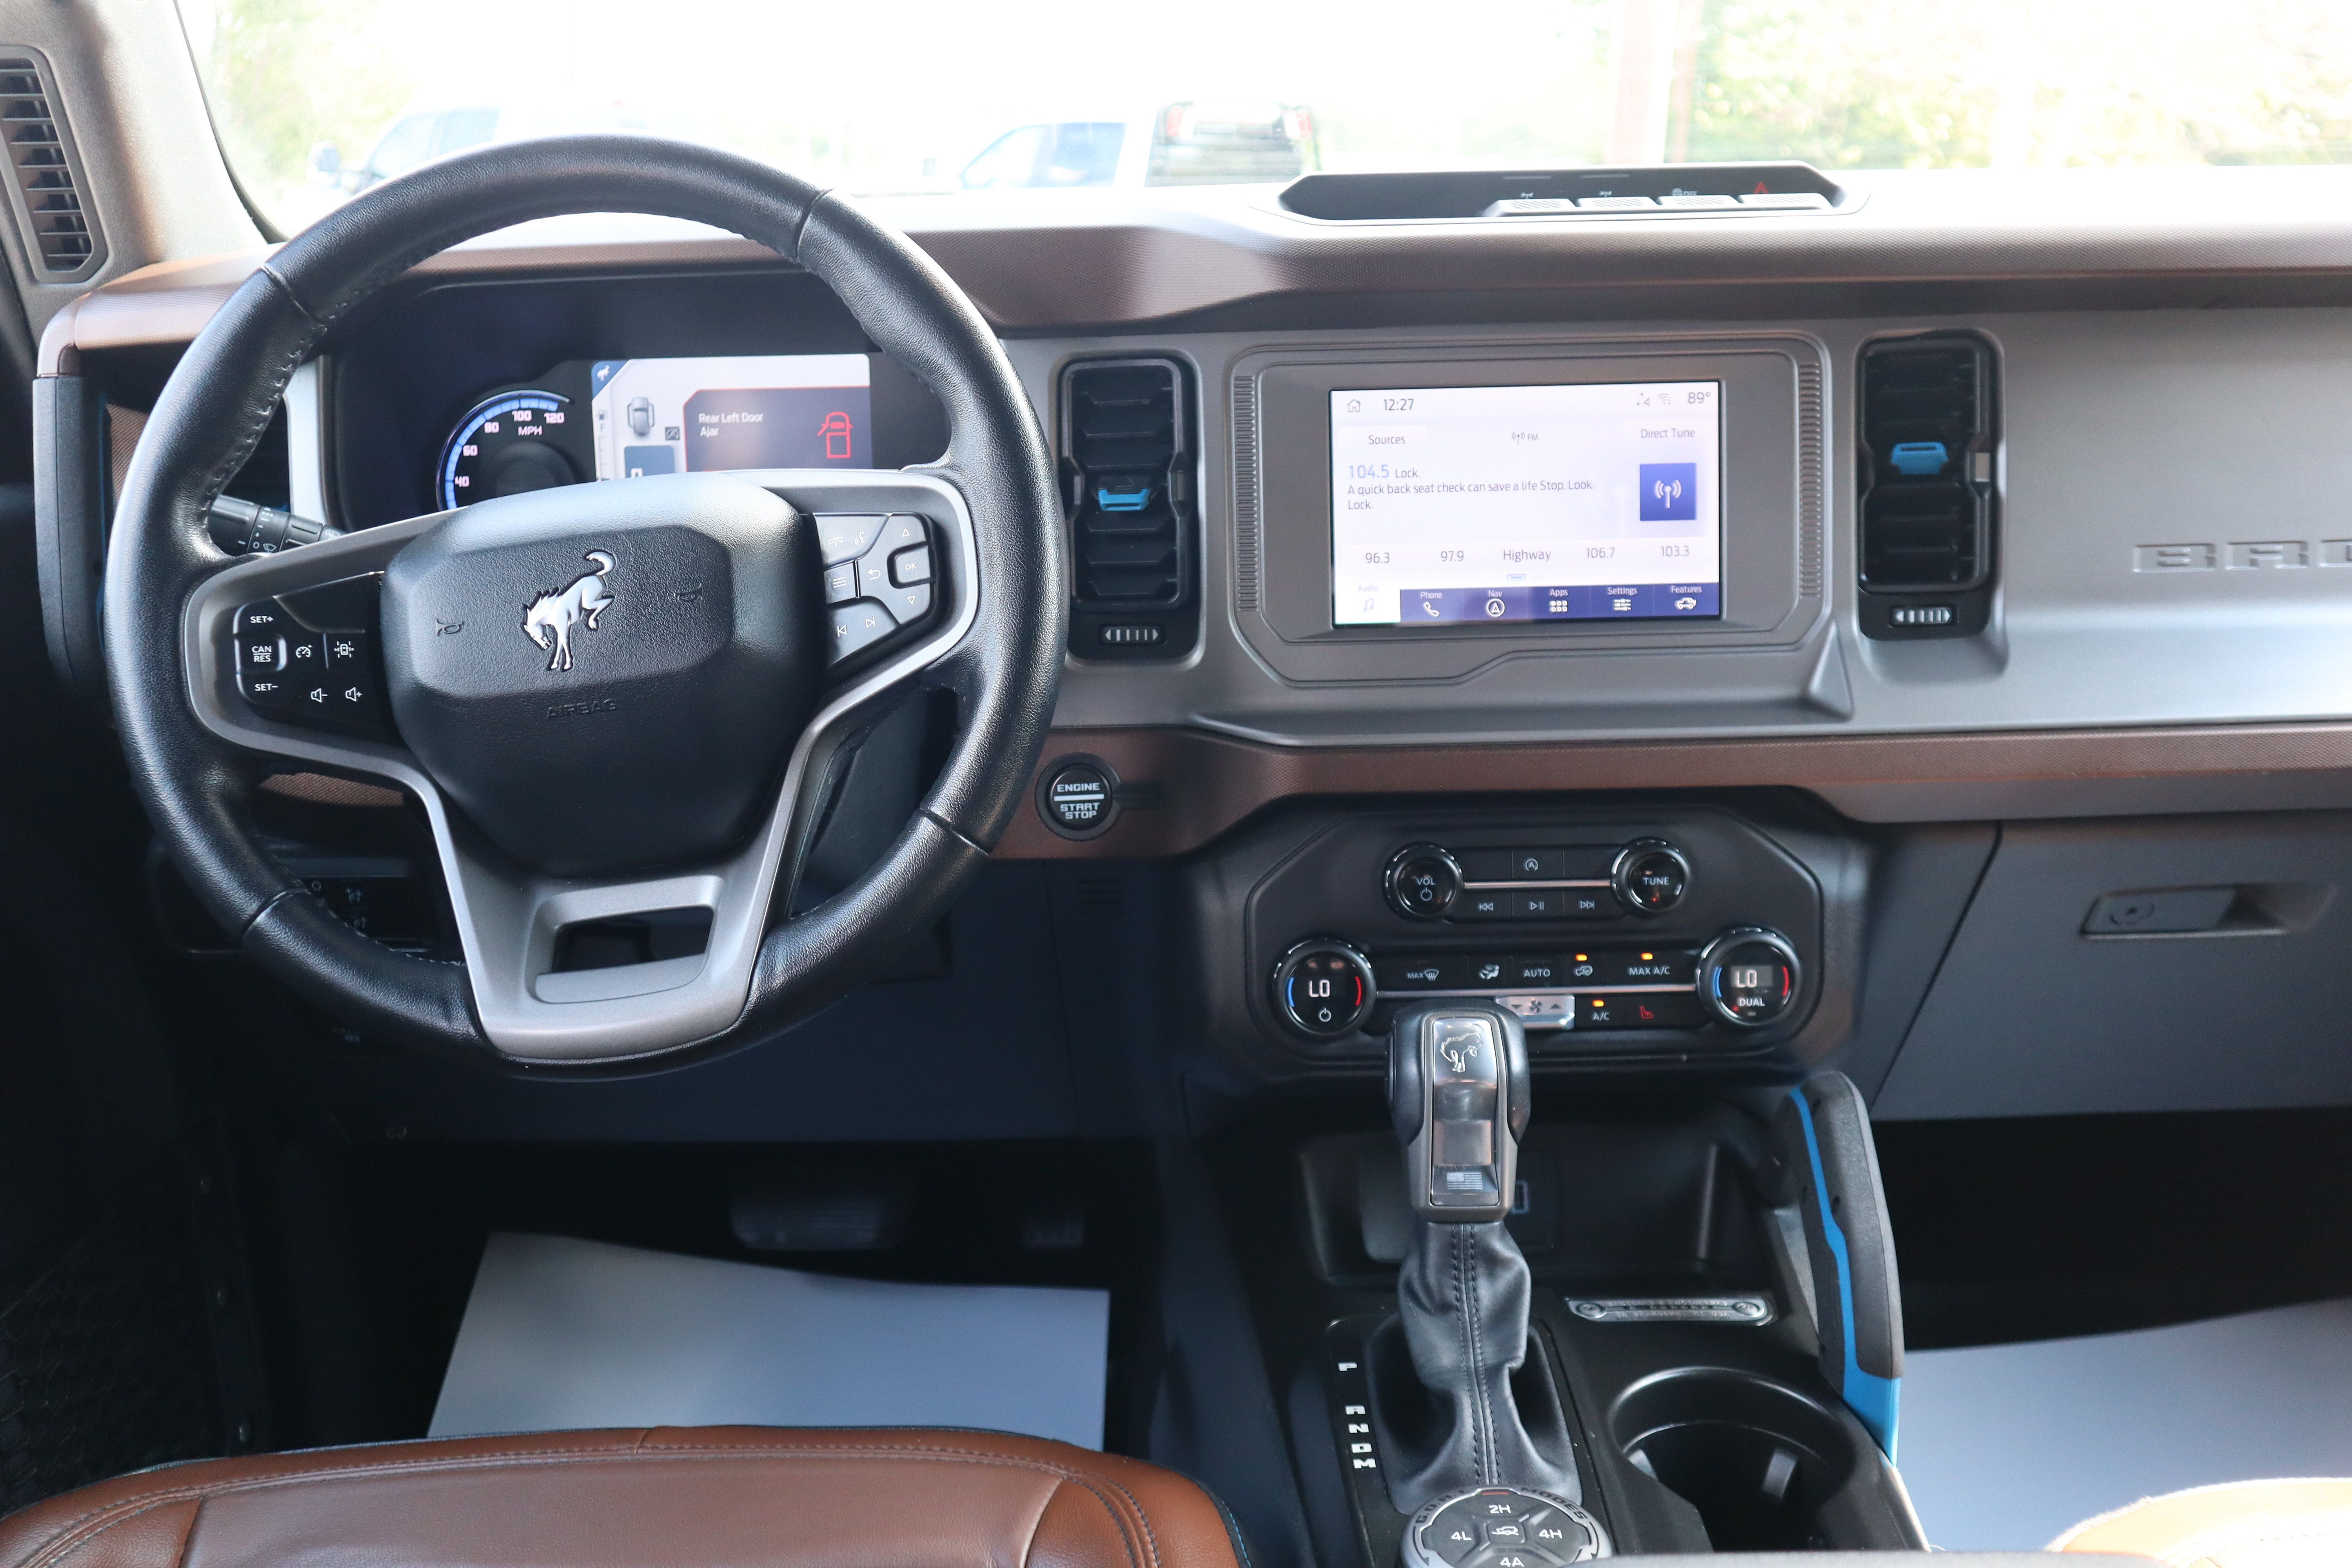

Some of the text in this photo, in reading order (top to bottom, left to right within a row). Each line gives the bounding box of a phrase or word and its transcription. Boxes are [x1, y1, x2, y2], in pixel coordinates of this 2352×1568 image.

[1383, 399, 1414, 411] 12:27
[512, 410, 532, 421] 100
[544, 412, 564, 423] 120
[699, 412, 764, 423] Rear Left Door
[484, 421, 499, 433] 80
[518, 425, 542, 436] MPH
[700, 426, 719, 437] Ajar
[1641, 428, 1695, 439] Direct Tune
[1369, 435, 1405, 444] Sources
[463, 445, 478, 457] 60
[1348, 464, 1420, 479] 104.5 Lock.
[454, 476, 470, 487] 40
[1348, 486, 1355, 494] A
[1358, 485, 1384, 496] quick
[1388, 483, 1410, 494] back
[1414, 483, 1434, 493] seat
[1437, 483, 1465, 493] check
[1468, 484, 1486, 492] can
[1488, 483, 1510, 492] save
[1522, 481, 1537, 490] life
[1540, 481, 1566, 492] Stop.
[1568, 480, 1595, 490] Look.
[1348, 500, 1373, 510] Lock.
[1441, 550, 1464, 562] 97.9
[1503, 549, 1551, 563] Highway
[1586, 547, 1615, 559] 106.7
[1661, 545, 1689, 557] 103.3
[1365, 552, 1390, 564] 96.3
[904, 561, 917, 571] OK
[1421, 591, 1443, 599] Phone
[1550, 588, 1568, 597] Apps
[1608, 587, 1638, 596] Settings
[255, 683, 279, 691] SET-
[547, 698, 617, 719] AIRBAG
[1057, 782, 1100, 792] ENGINE
[1060, 802, 1100, 811] START
[1065, 811, 1097, 820] STOP
[1417, 878, 1436, 886] VOL
[1643, 877, 1669, 885] TUNE
[1524, 969, 1551, 977] AUTO
[1629, 966, 1670, 976] MAX A/C
[1736, 969, 1757, 988] LO
[1308, 979, 1330, 998] LO
[1738, 998, 1765, 1007] DUAL
[1593, 1012, 1610, 1021] A/C
[1338, 1362, 1358, 1371] P
[1348, 1423, 1369, 1433] N
[1350, 1442, 1372, 1453] D
[1353, 1458, 1376, 1469] M
[1488, 1504, 1511, 1514] 2H
[1521, 1487, 1588, 1520] MODES
[1451, 1531, 1472, 1541] 4L
[1539, 1529, 1563, 1539] 4H
[1500, 1557, 1524, 1567] 4A
